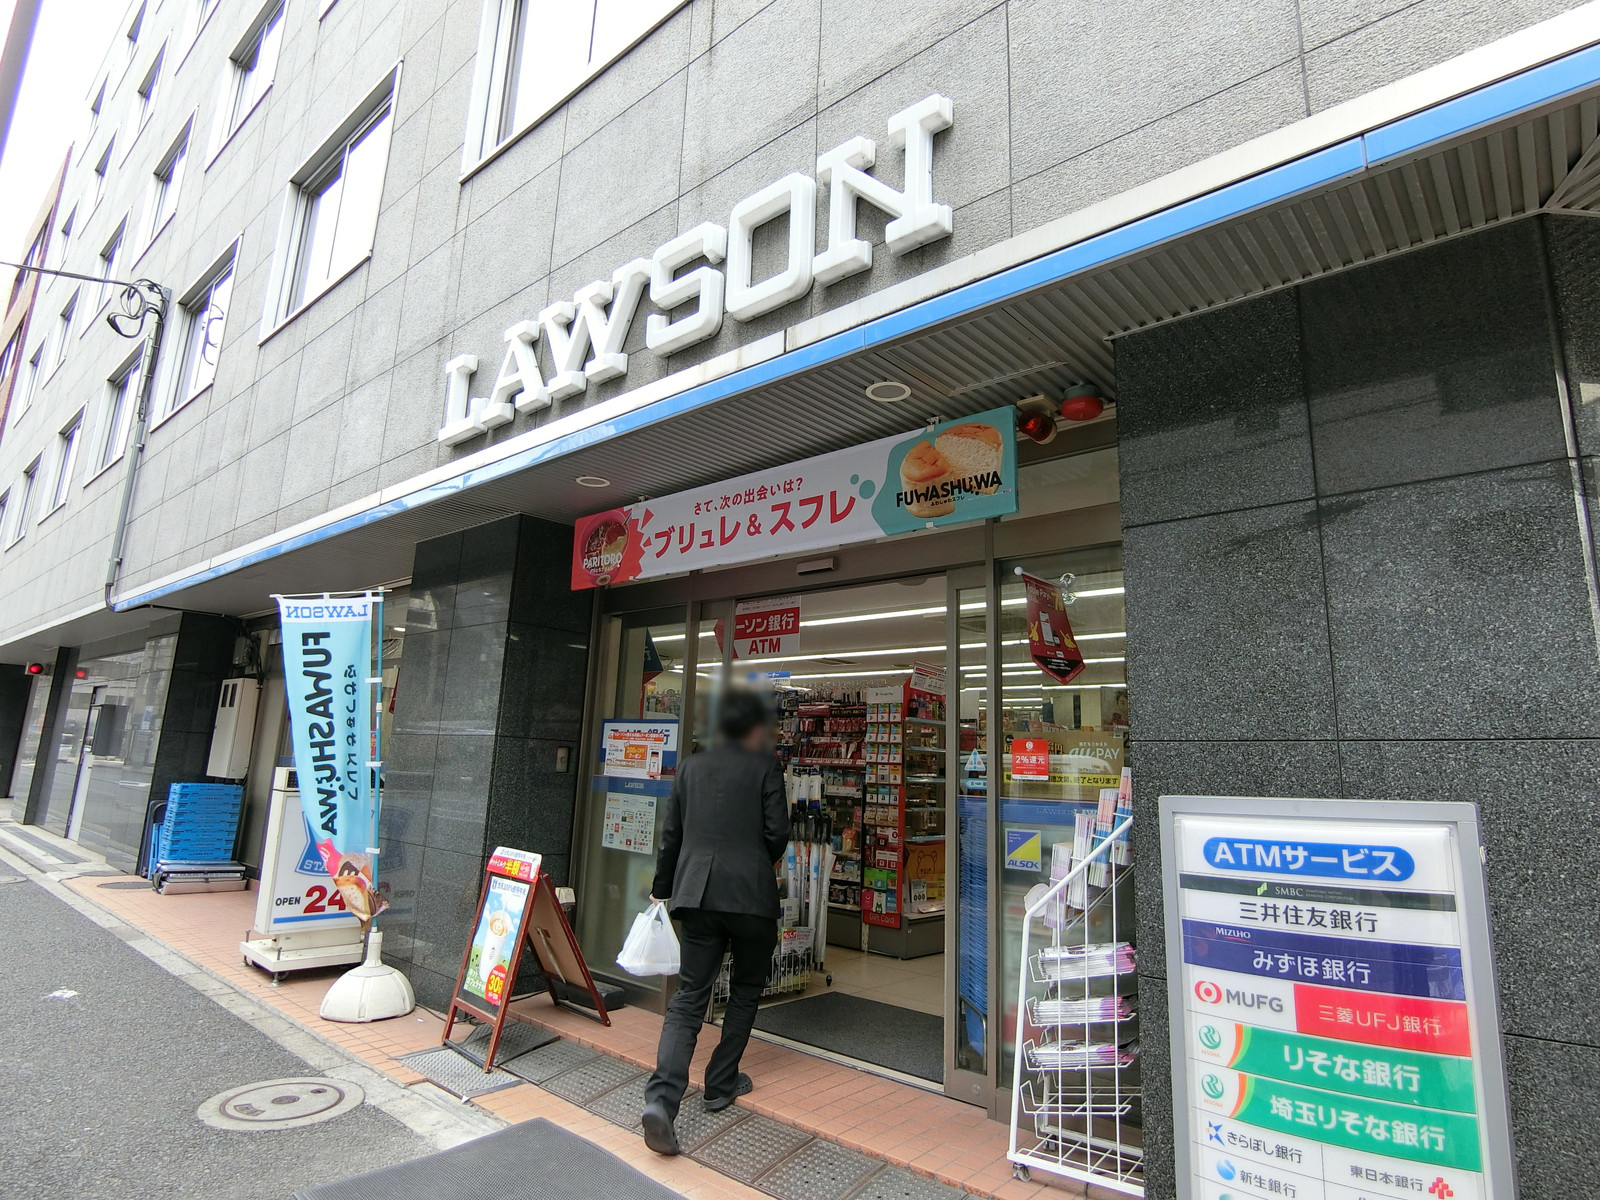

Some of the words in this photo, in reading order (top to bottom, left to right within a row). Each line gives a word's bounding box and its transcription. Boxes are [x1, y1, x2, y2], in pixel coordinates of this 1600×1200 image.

[438, 93, 954, 447] LAWSON
[694, 477, 804, 516] さて、次の出会いは?
[655, 515, 741, 559] ブリュレ
[769, 490, 856, 536] スフレ
[583, 552, 623, 569] PARITORO
[735, 613, 795, 633] ーソン銀行
[748, 637, 781, 655] ATM
[1096, 748, 1120, 760] PAY
[1007, 859, 1039, 869] ALSOK
[1213, 843, 1402, 878] ATMサービス
[275, 896, 301, 907] OPEN
[303, 884, 347, 914] 24
[1275, 886, 1304, 897] SMBC
[1239, 902, 1378, 933] 三井住友銀行
[1215, 927, 1251, 939] MIZUHO
[1253, 950, 1371, 984] みずほ銀行
[1226, 989, 1284, 1013] MUFG
[1318, 1004, 1442, 1037] 三菱UFJ銀行
[1283, 1045, 1421, 1092] りそな銀行
[1270, 1094, 1446, 1151] 埼玉りそな銀行
[1226, 1130, 1303, 1164] きらぼし銀行
[1239, 1170, 1297, 1199] 新生銀行
[1350, 1164, 1424, 1192] 東日本銀行
